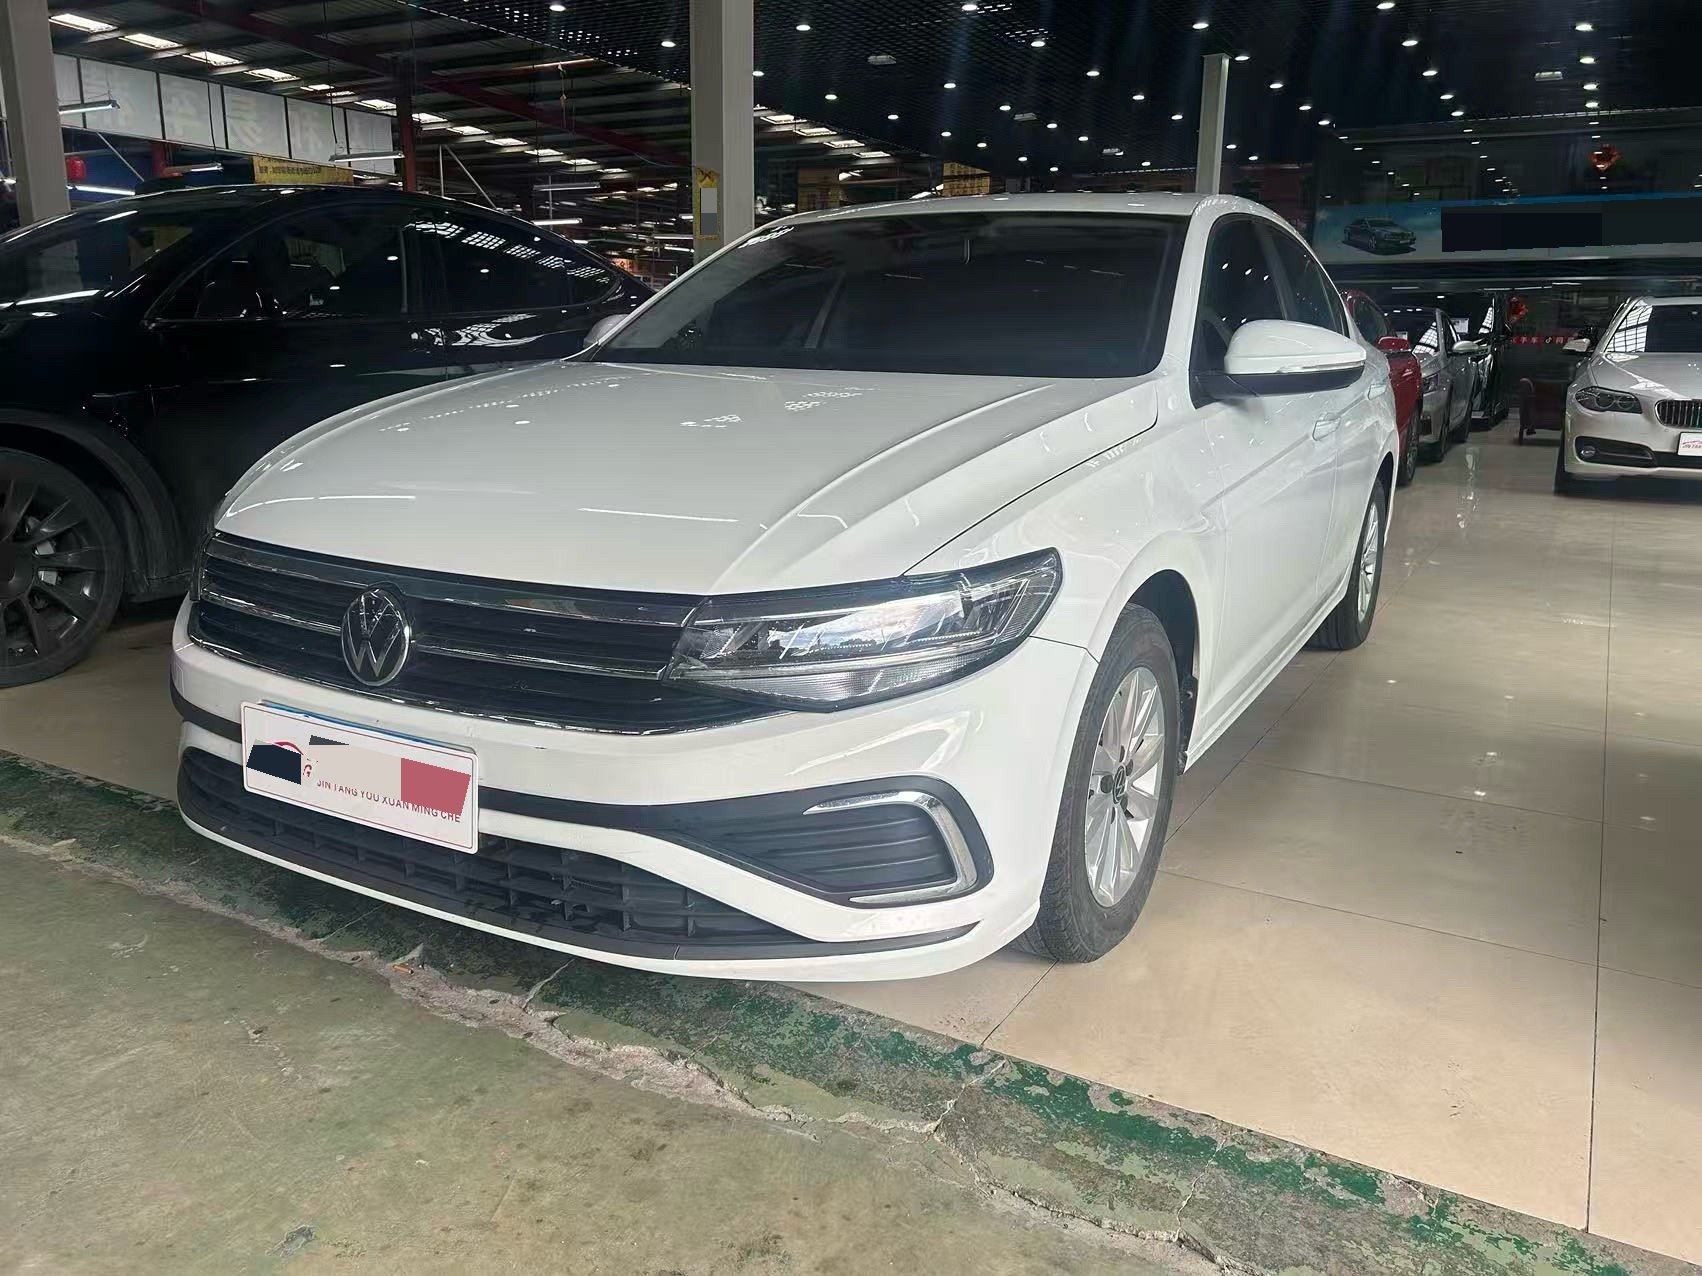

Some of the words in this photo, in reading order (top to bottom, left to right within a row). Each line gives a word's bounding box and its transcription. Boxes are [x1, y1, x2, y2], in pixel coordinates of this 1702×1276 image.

[361, 790, 380, 802] YOU
[382, 796, 409, 811] XUAN
[411, 802, 438, 818] MING
[440, 809, 461, 823] CHE
